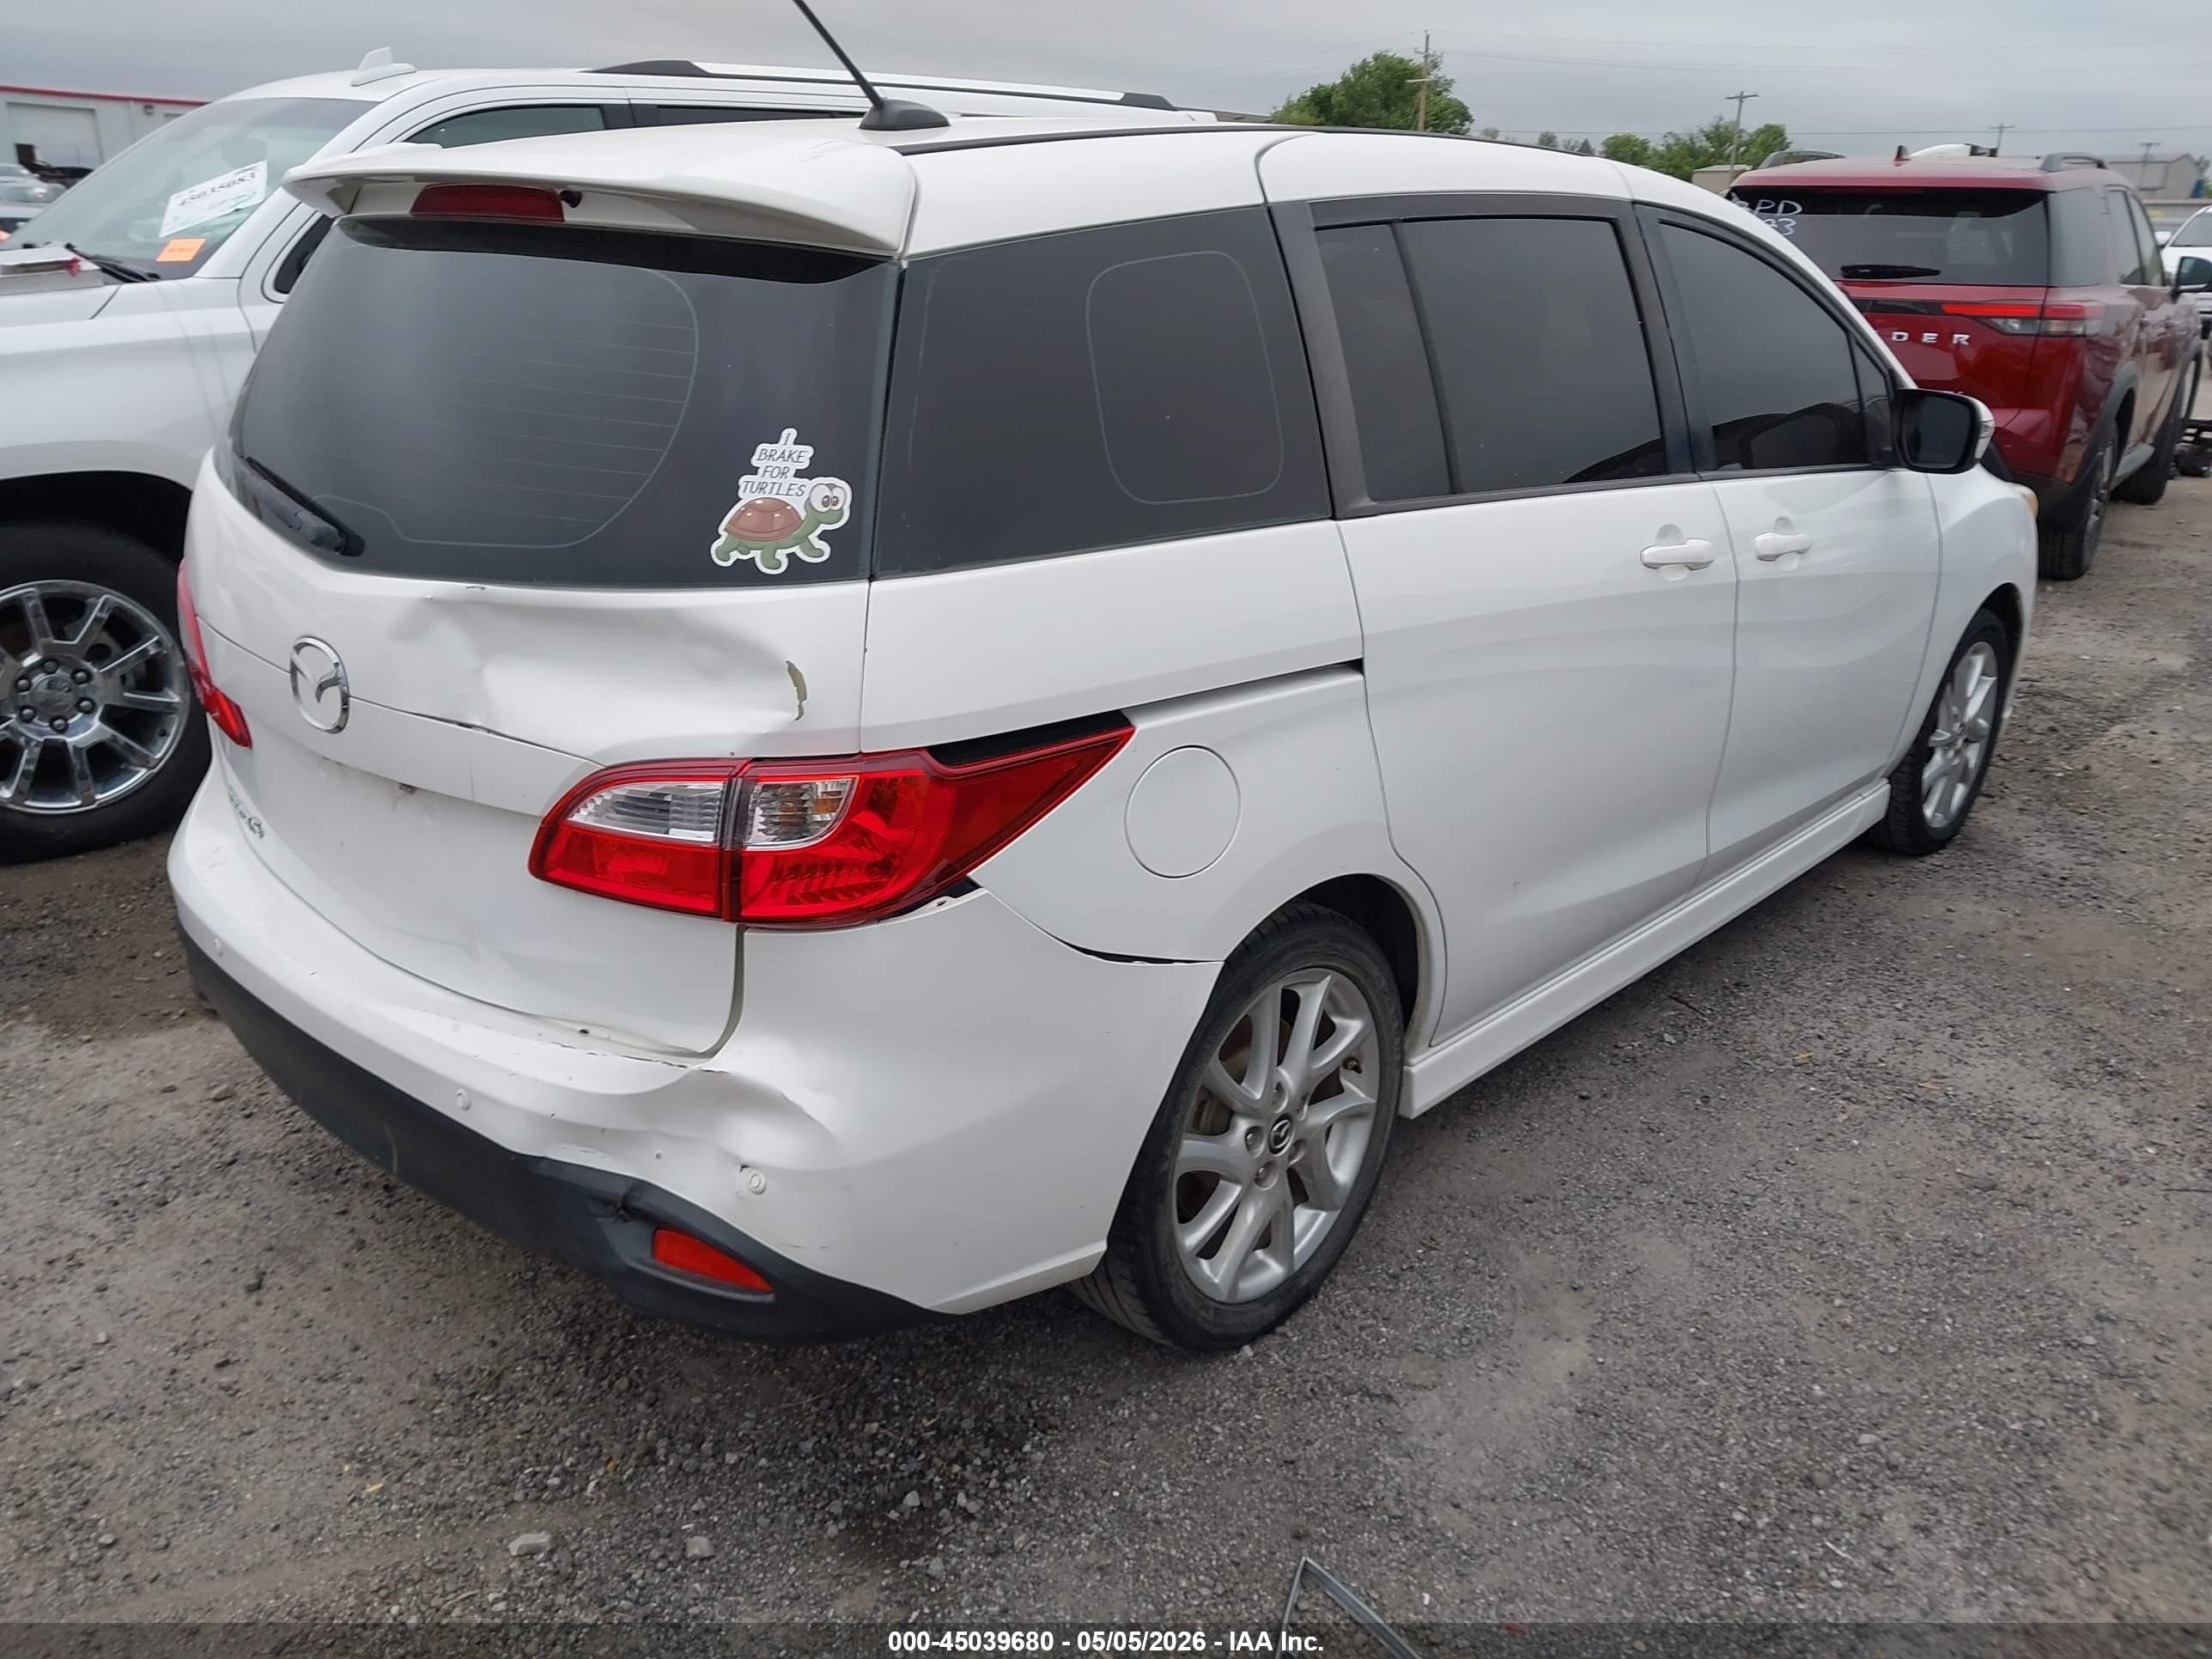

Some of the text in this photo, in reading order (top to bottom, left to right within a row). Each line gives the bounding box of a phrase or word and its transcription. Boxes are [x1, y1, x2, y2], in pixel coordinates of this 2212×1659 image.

[782, 432, 792, 446] I
[757, 448, 810, 464] BRAKE
[762, 465, 791, 479] FOR
[742, 480, 807, 497] TURTLES
